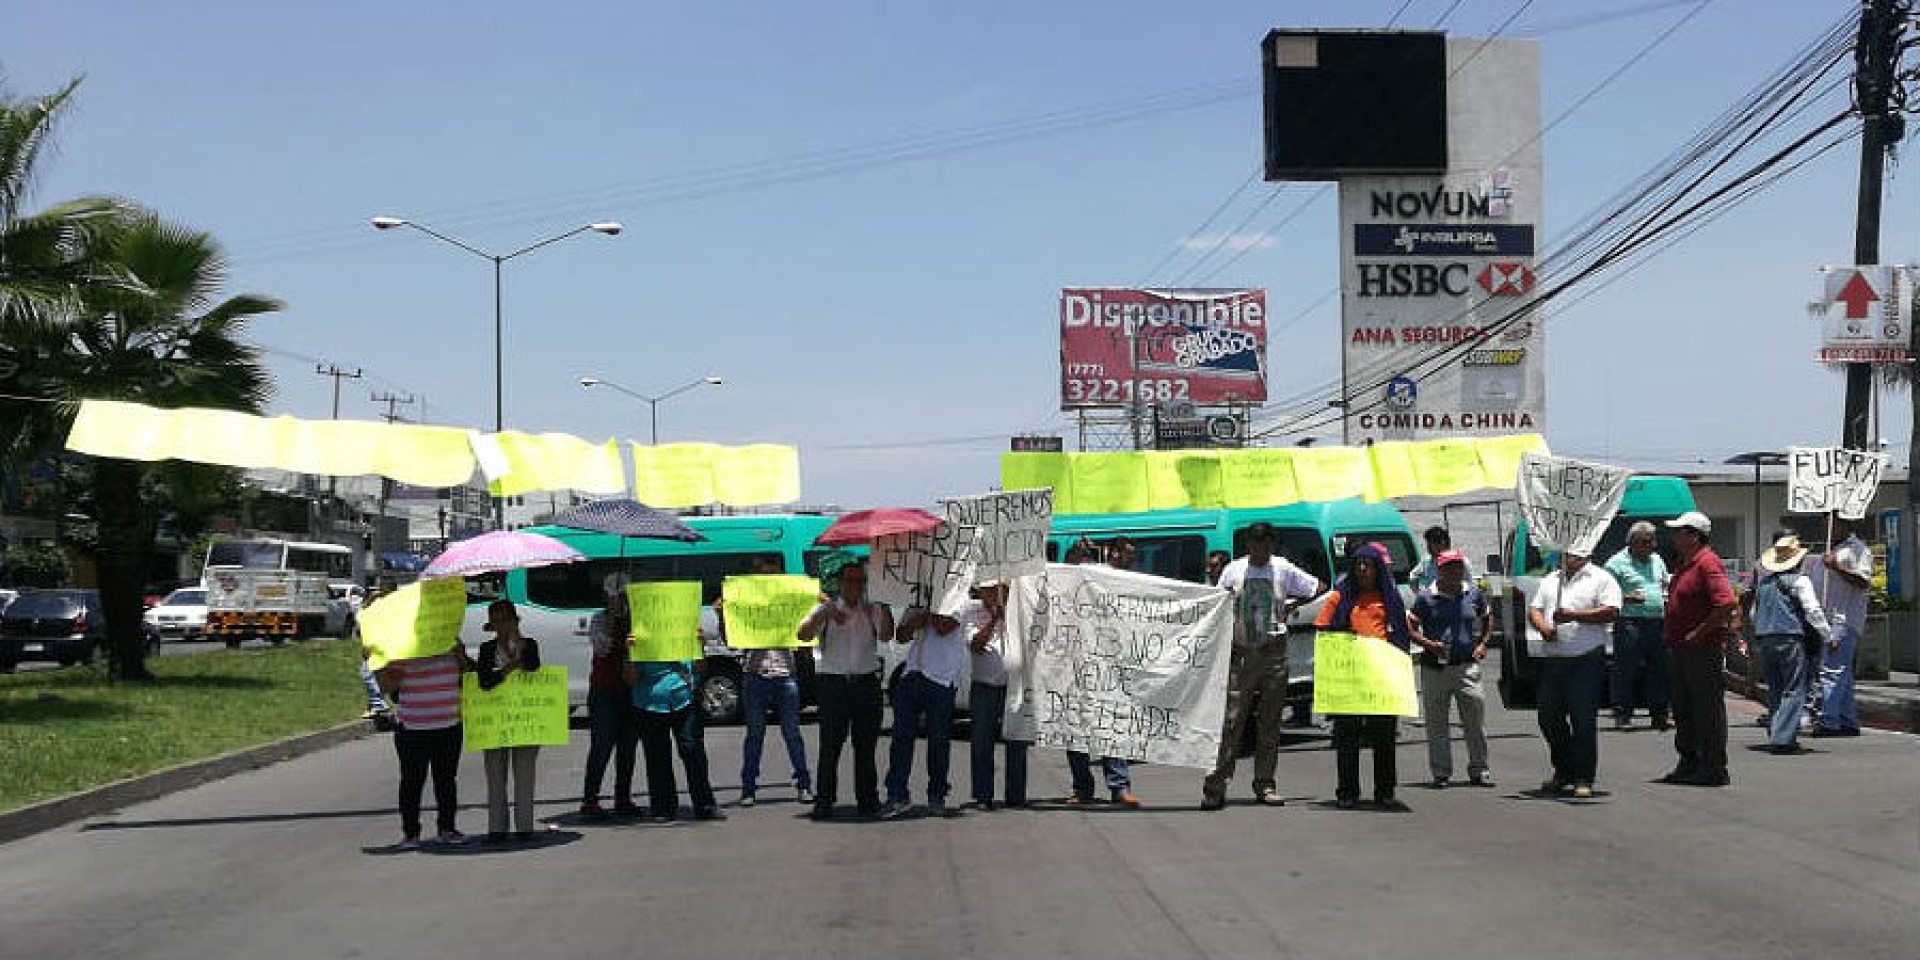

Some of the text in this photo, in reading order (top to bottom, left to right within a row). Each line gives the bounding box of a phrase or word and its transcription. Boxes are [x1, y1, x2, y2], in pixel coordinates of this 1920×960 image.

[1371, 185, 1490, 217] NOVUM
[1357, 263, 1469, 297] HSBC
[1066, 294, 1263, 336] Disponible
[1352, 328, 1395, 343] ANA
[1402, 328, 1490, 342] SEGUROS
[1066, 379, 1189, 401] 3221682
[1360, 413, 1533, 429] COMIDA CHINA
[1524, 463, 1610, 502] FUERA
[1796, 450, 1879, 485] FUERA
[944, 490, 1053, 526] QUEREMOS
[876, 524, 975, 562] UERA
[1131, 630, 1164, 667] NO
[1177, 635, 1208, 668] SE
[1073, 658, 1134, 697] VENDE
